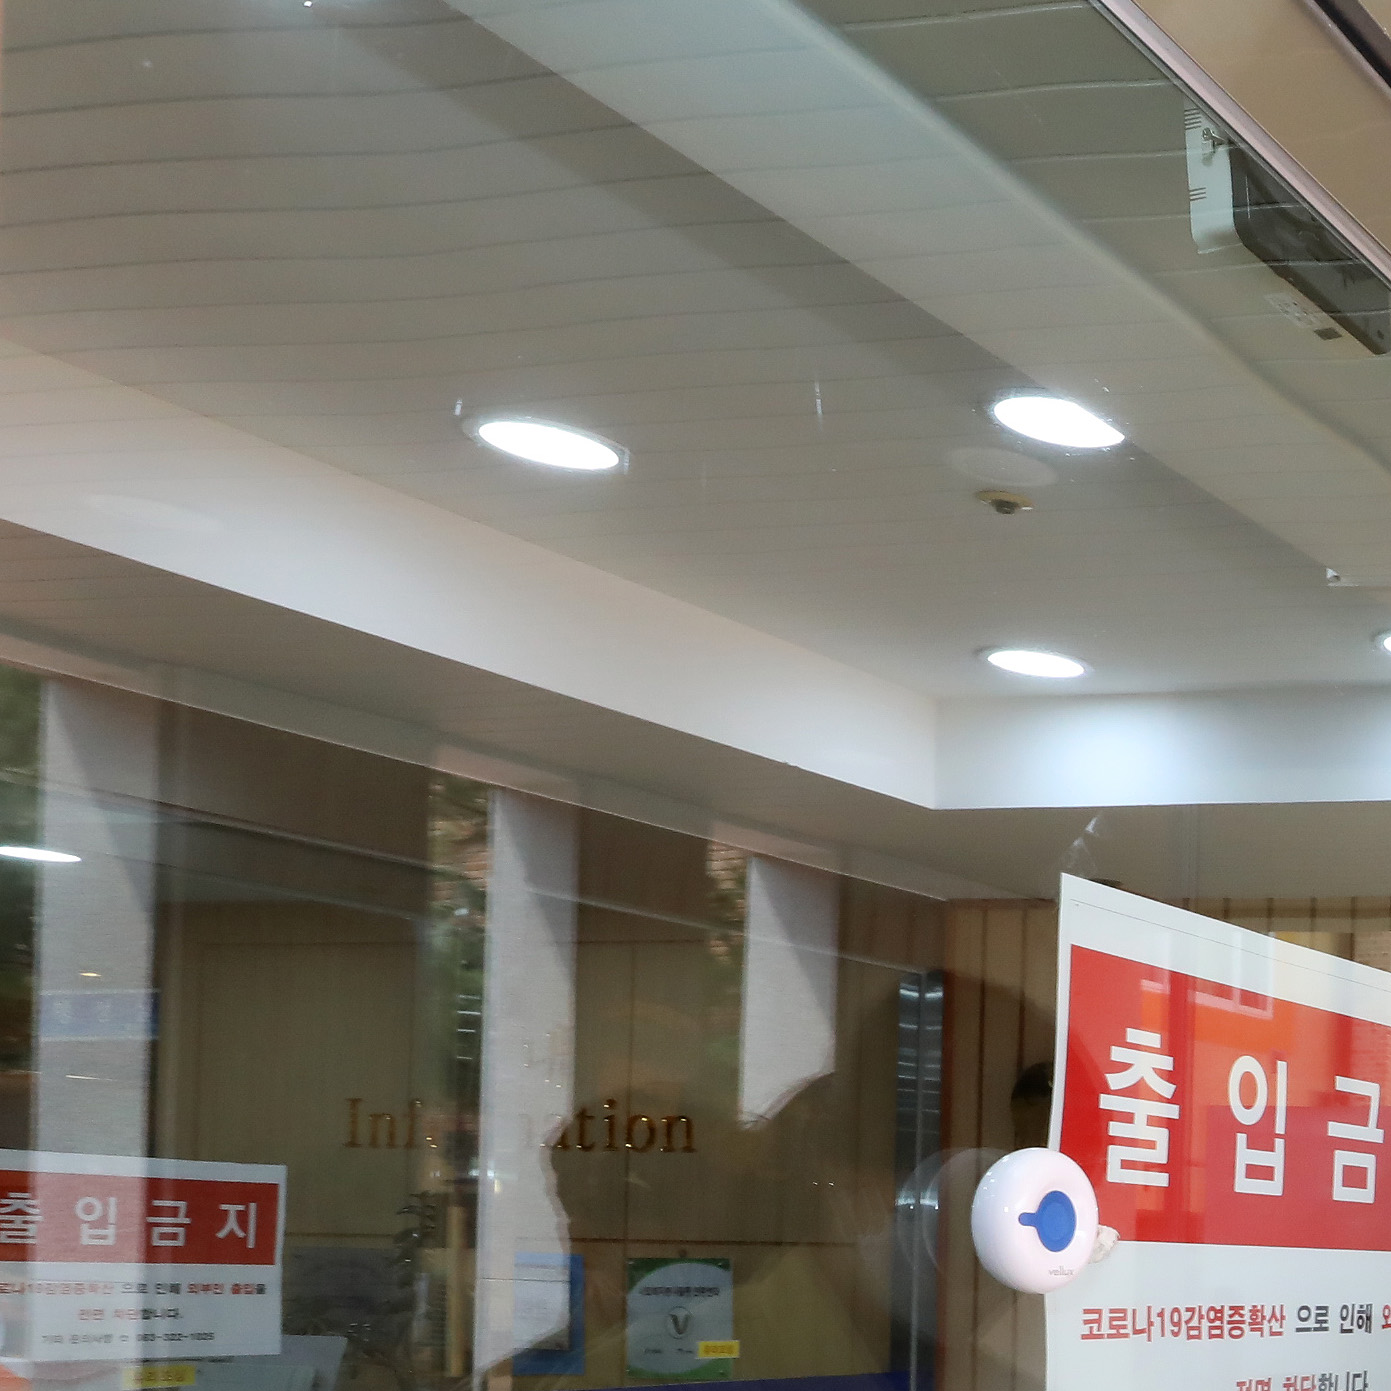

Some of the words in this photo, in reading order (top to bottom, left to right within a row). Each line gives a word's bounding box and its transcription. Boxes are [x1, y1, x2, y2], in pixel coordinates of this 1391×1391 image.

[342, 1098, 697, 1153] Infation
[1080, 1304, 1286, 1342] 코로나19감염증확산
[1295, 1305, 1330, 1333] 으로
[1340, 1303, 1373, 1334] 인해
